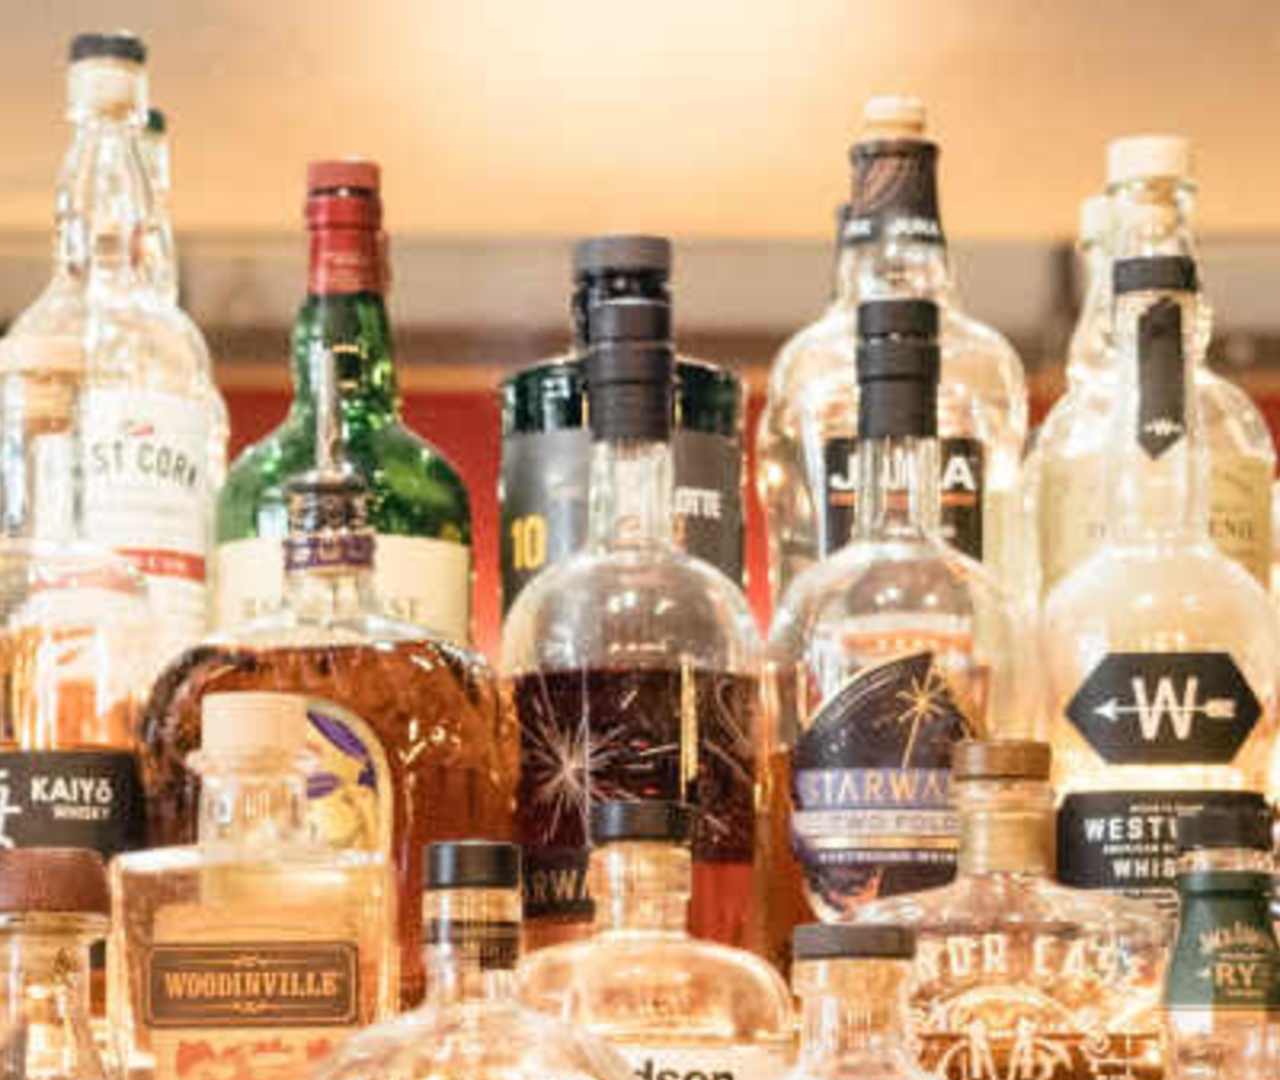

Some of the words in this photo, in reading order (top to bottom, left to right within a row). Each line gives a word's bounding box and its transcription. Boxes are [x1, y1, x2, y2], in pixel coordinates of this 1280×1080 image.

[1133, 676, 1198, 741] W
[800, 767, 951, 807] STARWA
[163, 970, 342, 998] WOODINVILLE
